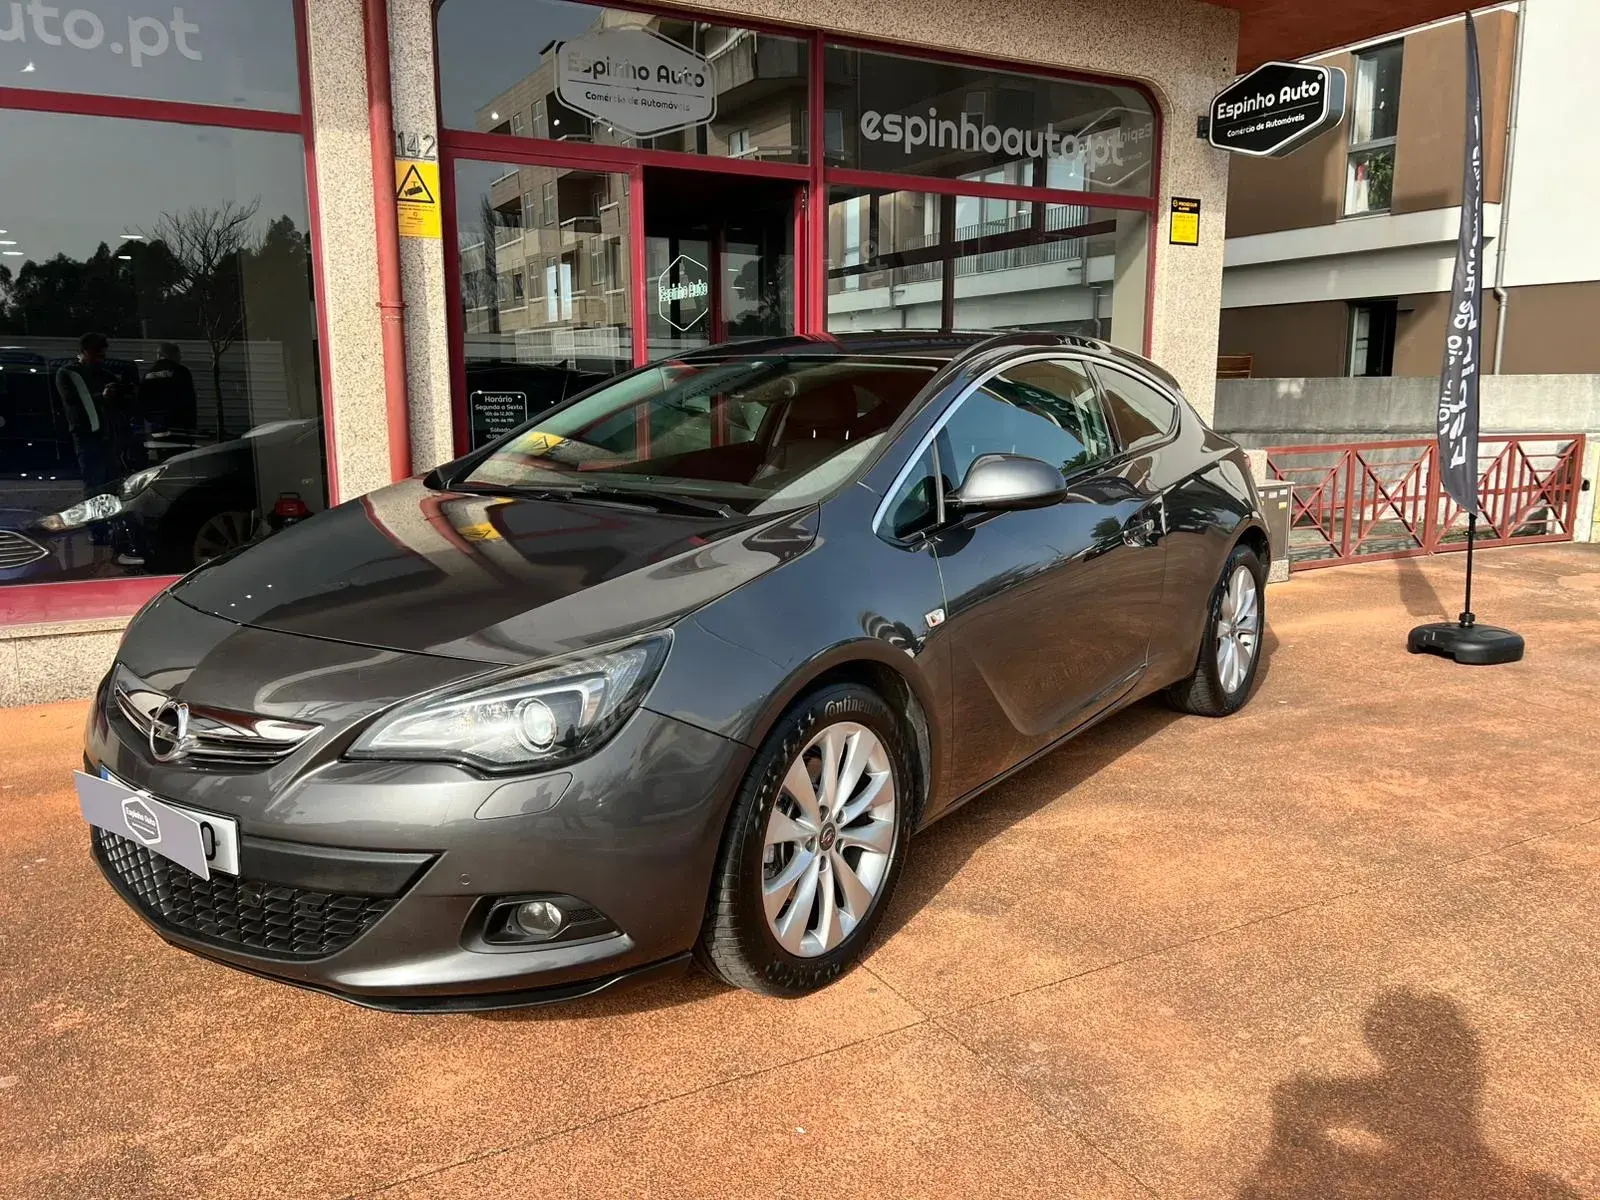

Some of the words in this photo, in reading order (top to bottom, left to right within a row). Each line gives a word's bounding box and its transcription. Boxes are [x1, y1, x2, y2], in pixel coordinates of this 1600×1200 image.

[1217, 92, 1275, 120] Espinho
[1279, 80, 1320, 104] Auto
[860, 107, 1124, 174] espinhoauto.pt
[1226, 125, 1255, 138] Comércio
[1255, 122, 1265, 131] de
[1265, 112, 1305, 129] Automóveis
[397, 130, 436, 161] 142
[484, 395, 512, 403] Horário
